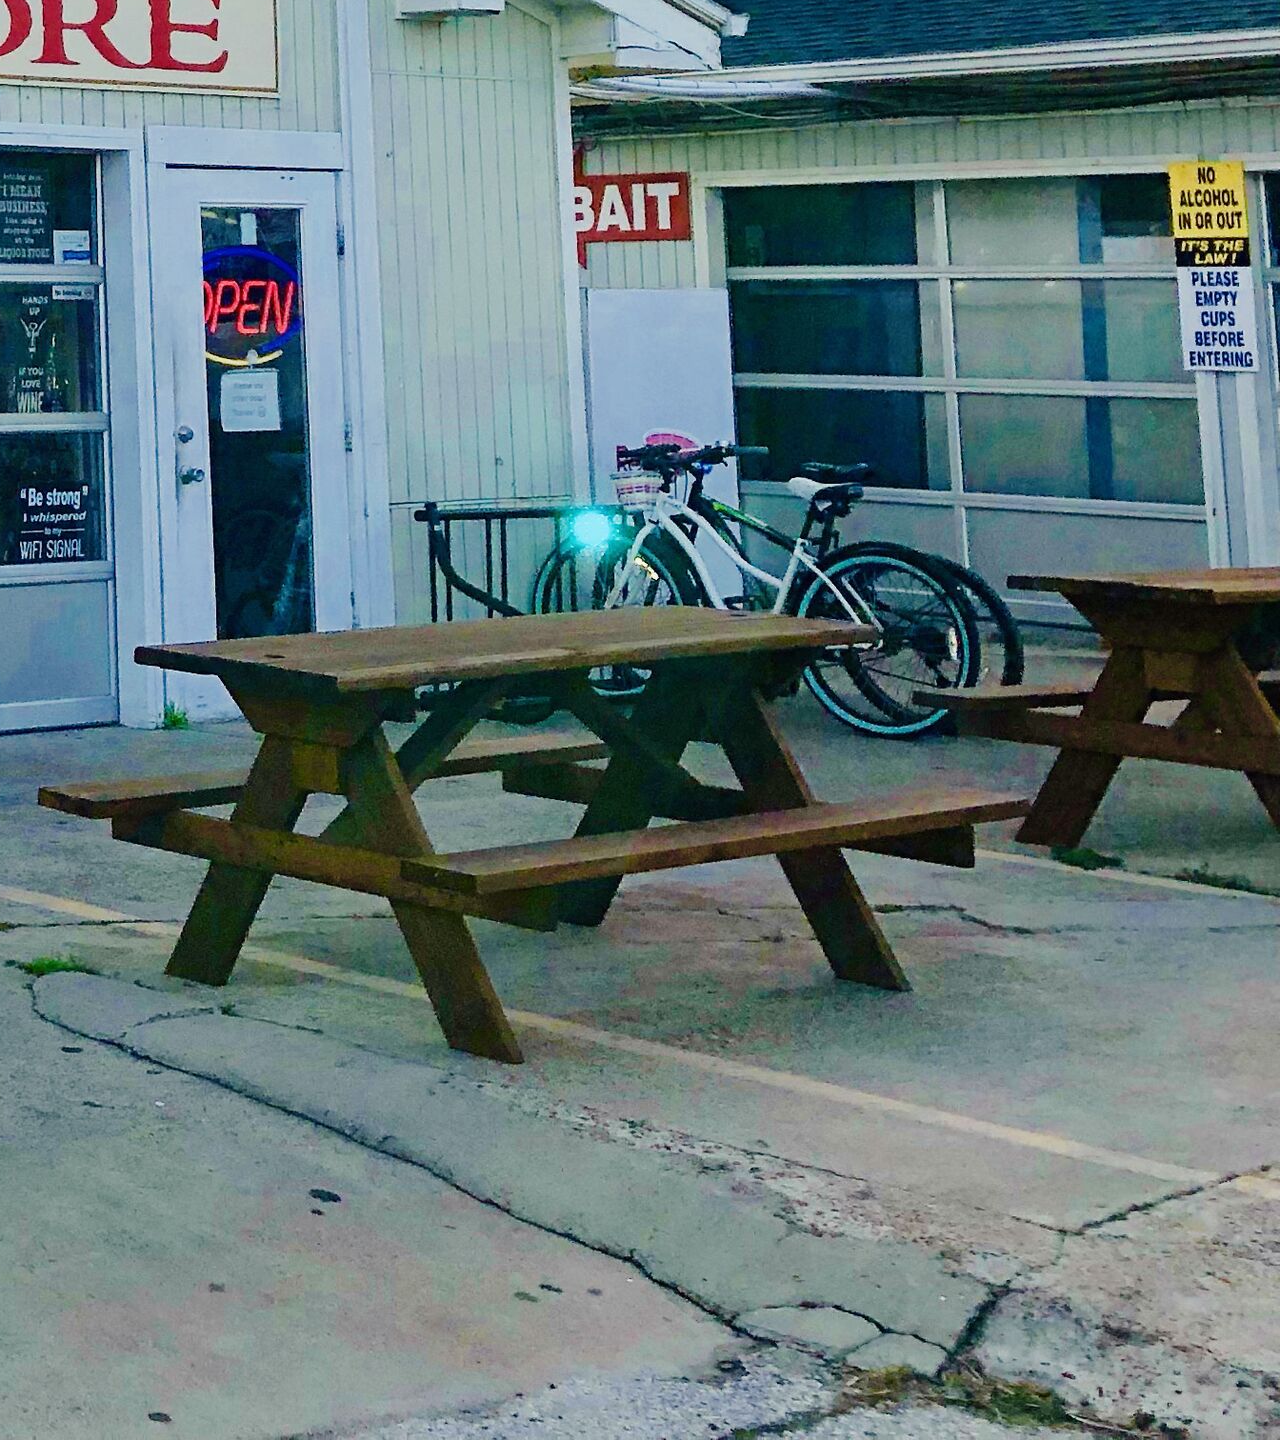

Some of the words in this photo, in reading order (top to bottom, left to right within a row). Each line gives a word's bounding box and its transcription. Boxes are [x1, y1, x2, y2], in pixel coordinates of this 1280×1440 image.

[1198, 167, 1215, 184] NO
[1180, 190, 1239, 207] ALCOHOL
[574, 182, 679, 232] BAIT
[1179, 213, 1191, 230] IN
[1196, 212, 1213, 229] OR
[1217, 211, 1242, 228] OUT
[1181, 239, 1208, 253] IT'S
[1214, 239, 1244, 251] THE
[1192, 271, 1239, 287] PLEASE
[22, 296, 48, 304] HANDS
[1196, 291, 1237, 306] EMPTY
[30, 307, 40, 315] UP
[1201, 311, 1235, 326] CUPS
[1195, 330, 1245, 347] BEFORE
[1190, 351, 1253, 368] ENTERING
[24, 513, 27, 522] I
[30, 511, 87, 523] whispered
[20, 541, 42, 559] WIFI
[47, 539, 85, 558] SIGNAL
